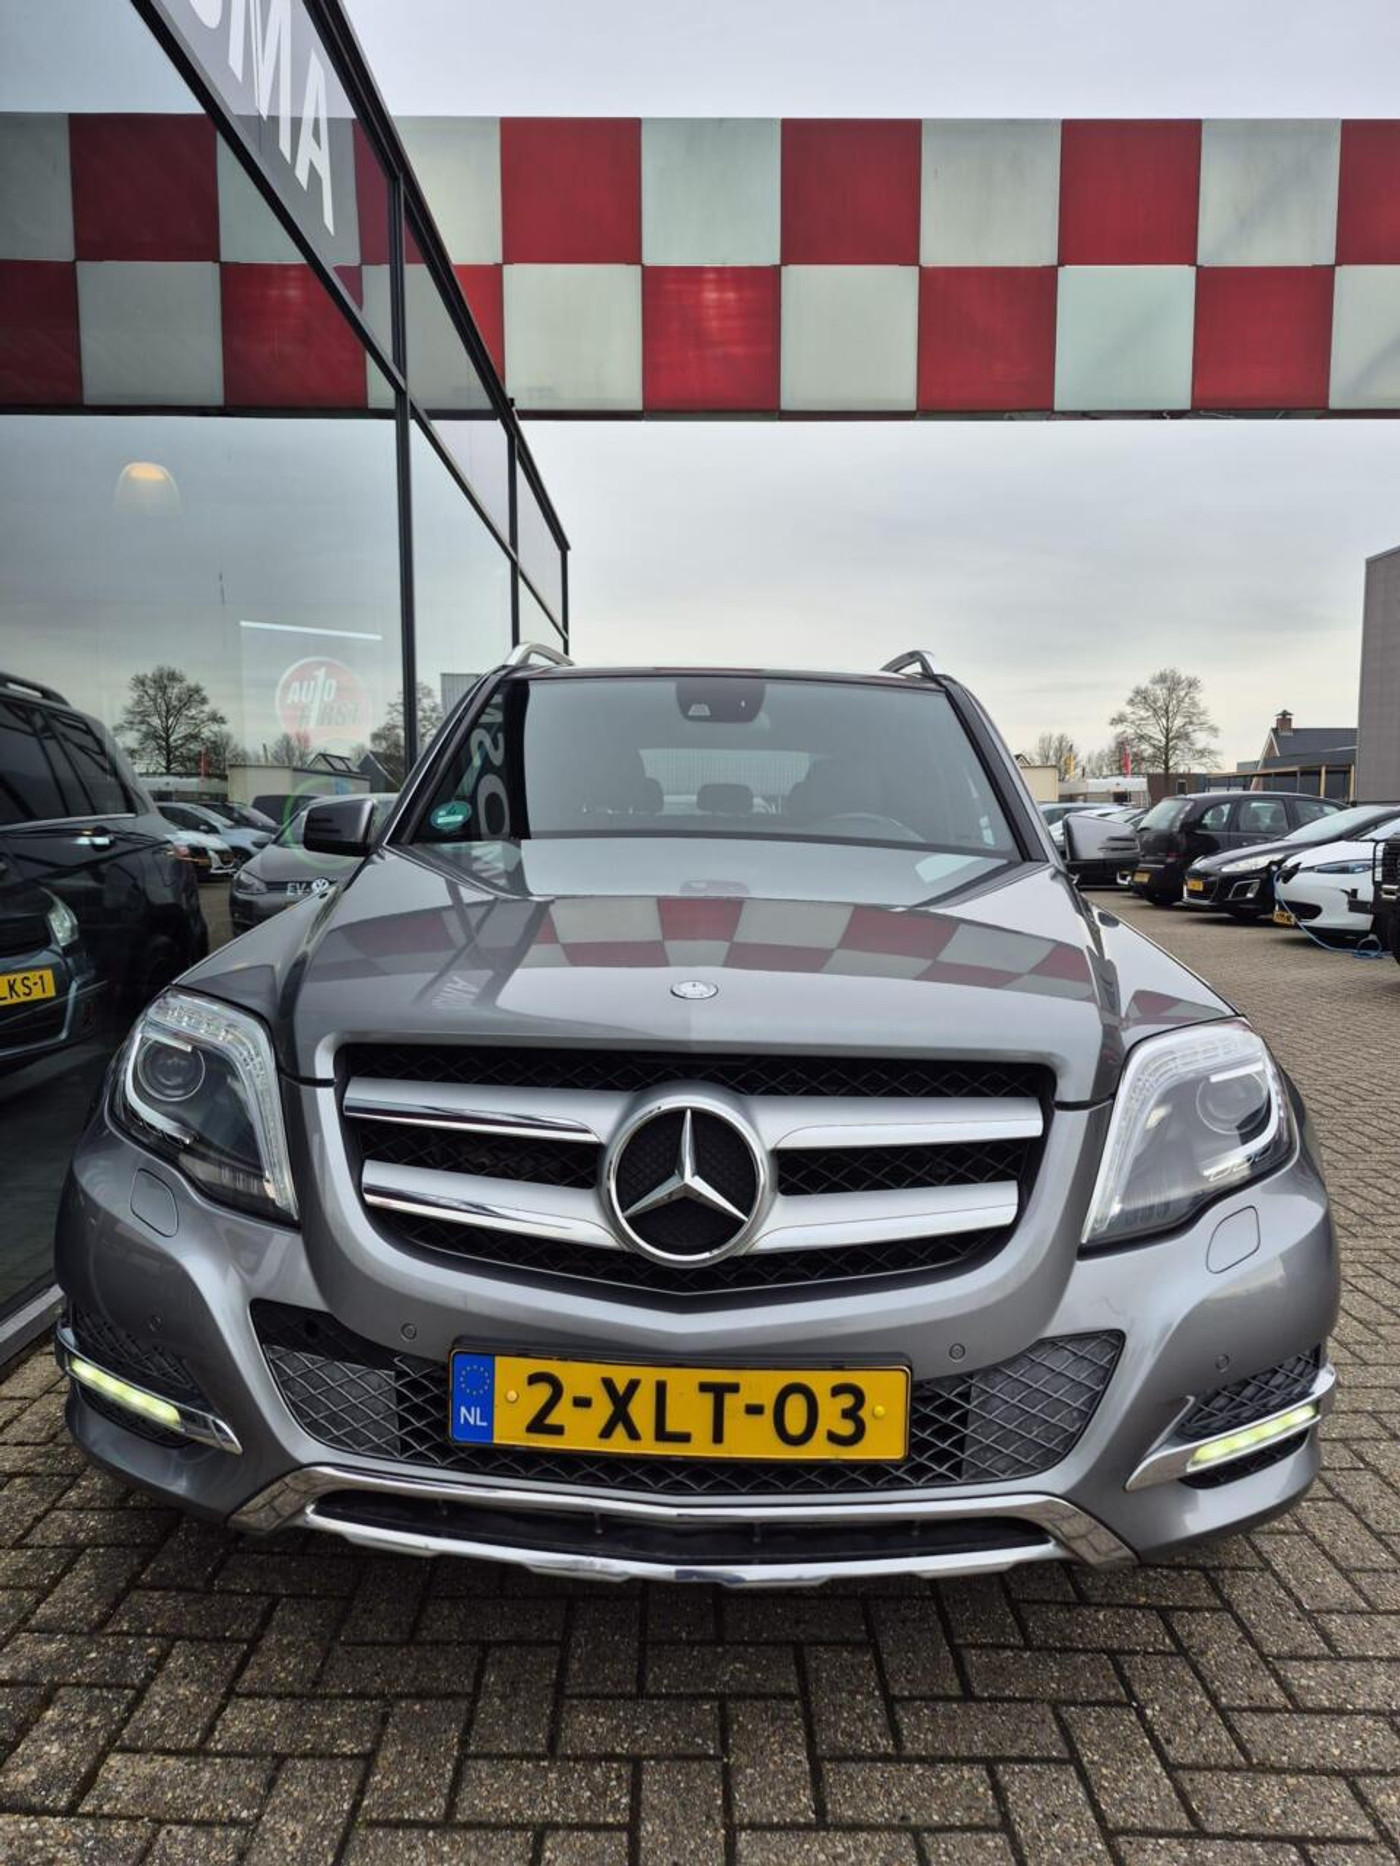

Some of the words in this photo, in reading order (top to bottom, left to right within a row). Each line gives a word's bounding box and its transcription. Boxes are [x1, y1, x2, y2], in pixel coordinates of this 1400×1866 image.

[190, 0, 336, 237] MA
[459, 1405, 488, 1427] NL
[525, 1371, 867, 1447] 2-XLT-03
